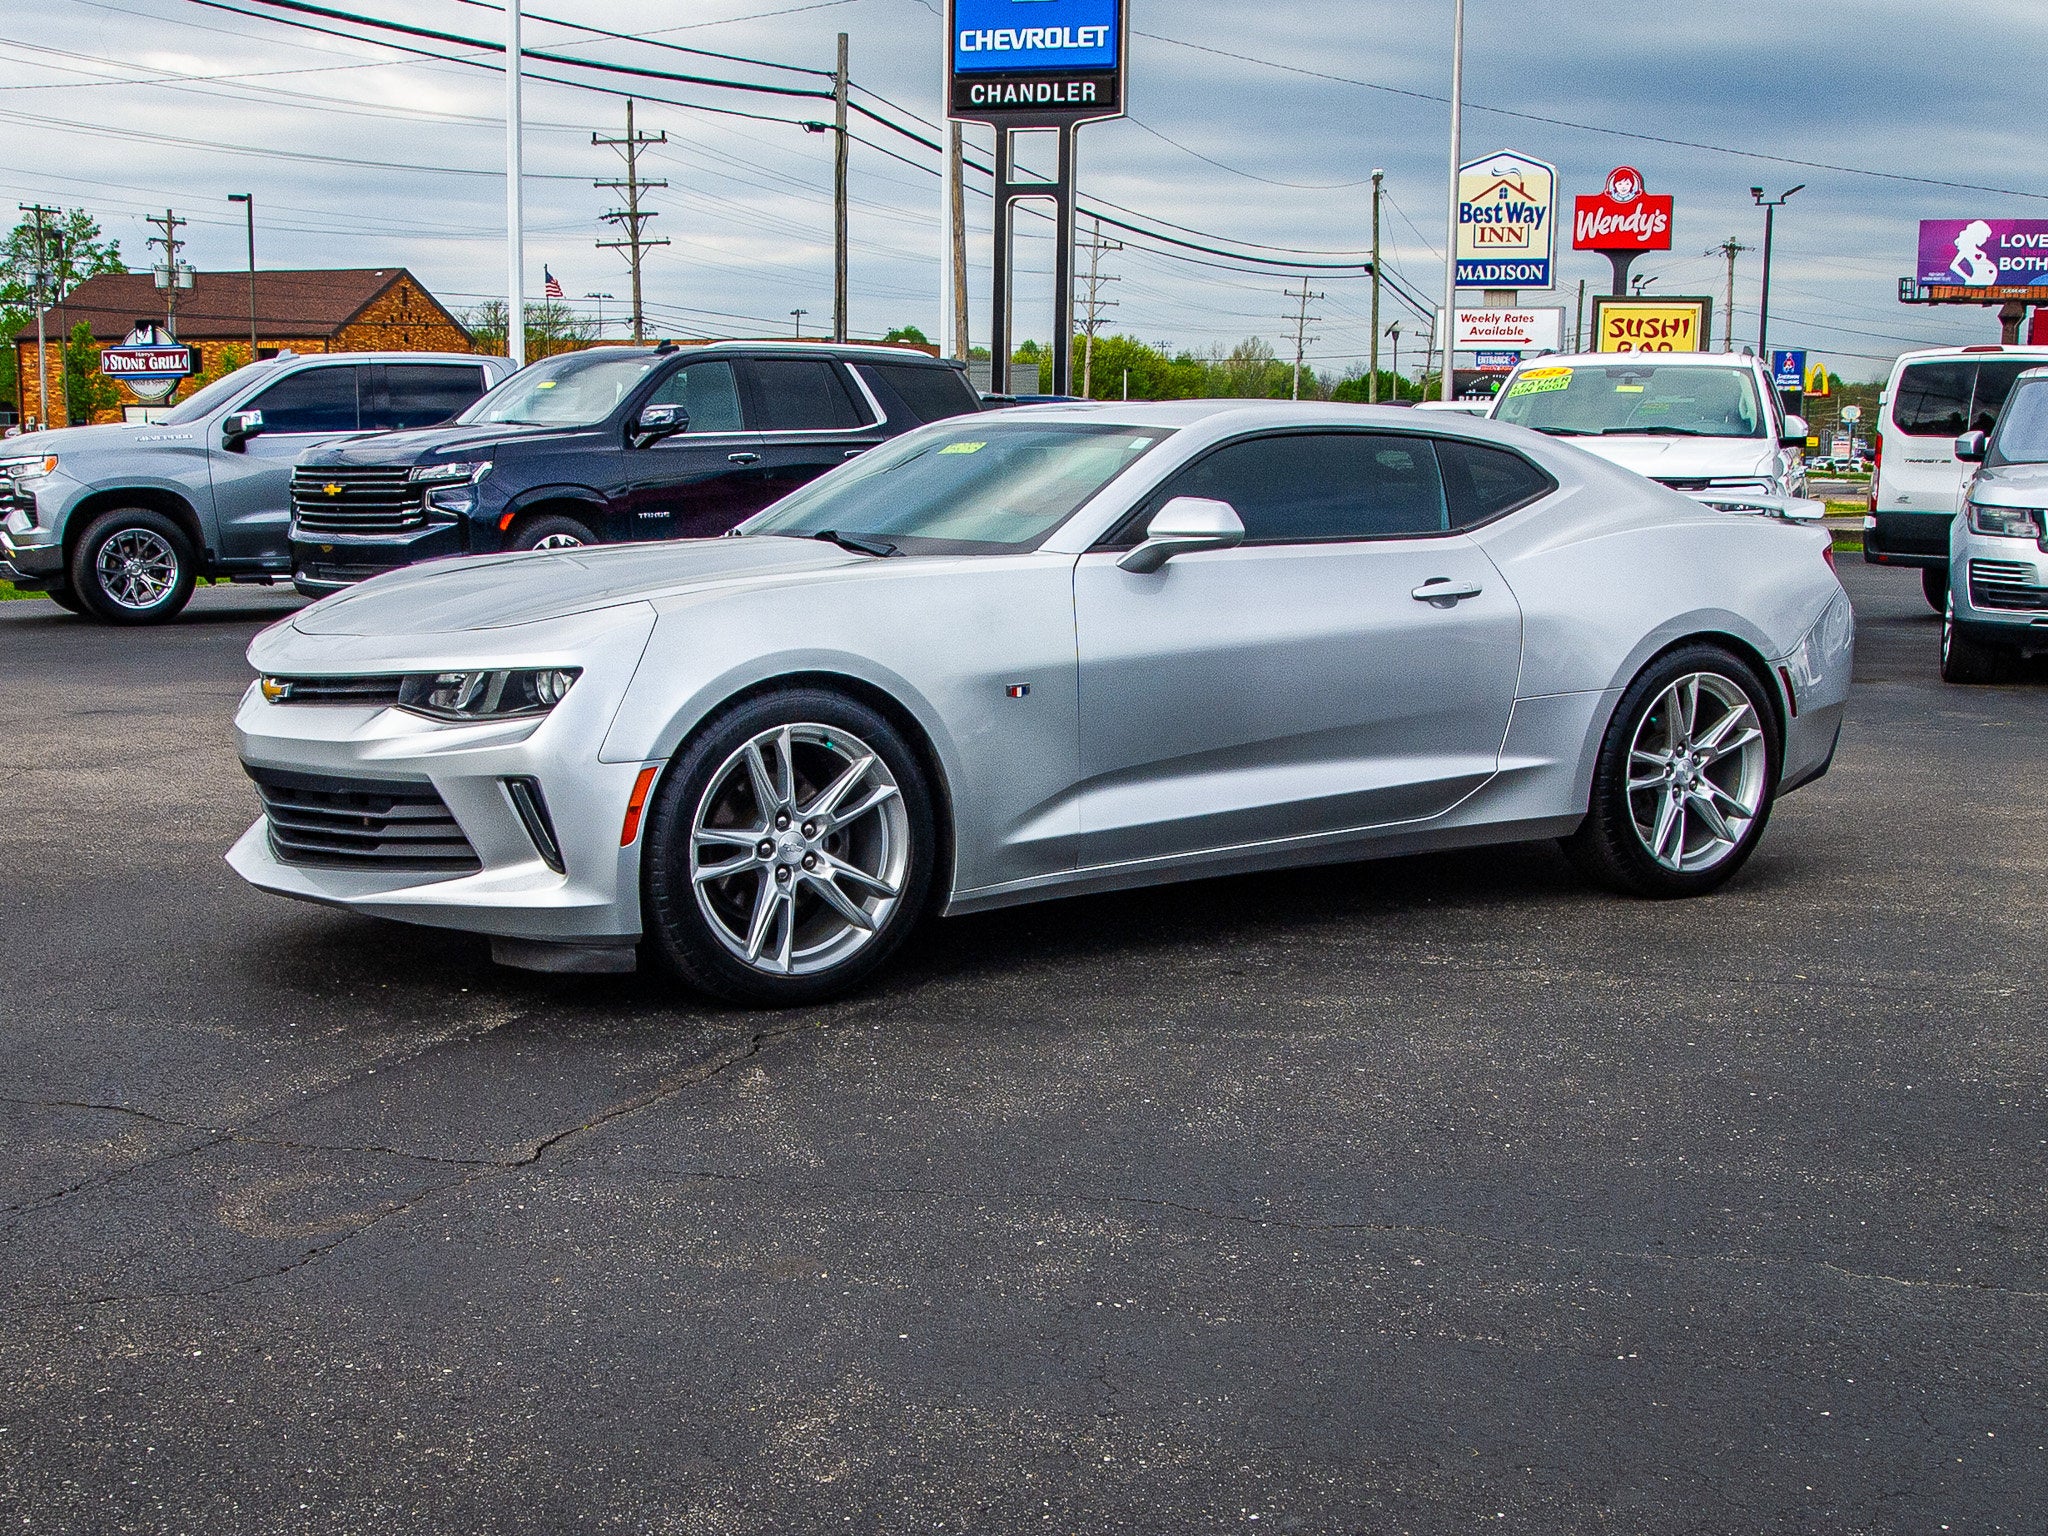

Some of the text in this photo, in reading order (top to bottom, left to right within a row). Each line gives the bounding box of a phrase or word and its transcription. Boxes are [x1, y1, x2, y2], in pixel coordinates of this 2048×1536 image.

[960, 25, 1110, 52] CHEVROLET
[970, 82, 1096, 104] CHANDLER
[1459, 201, 1547, 231] Best Way
[1576, 202, 1668, 242] Wendy's
[1478, 226, 1525, 243] INN
[2000, 233, 2048, 248] LOVE
[1999, 256, 2048, 271] BOTH
[1456, 264, 1544, 280] MADISON
[1460, 313, 1535, 325] Weekly Rates
[1469, 326, 1525, 336] Available
[1608, 317, 1690, 338] SUSHI
[109, 354, 182, 370] STONE GRILL
